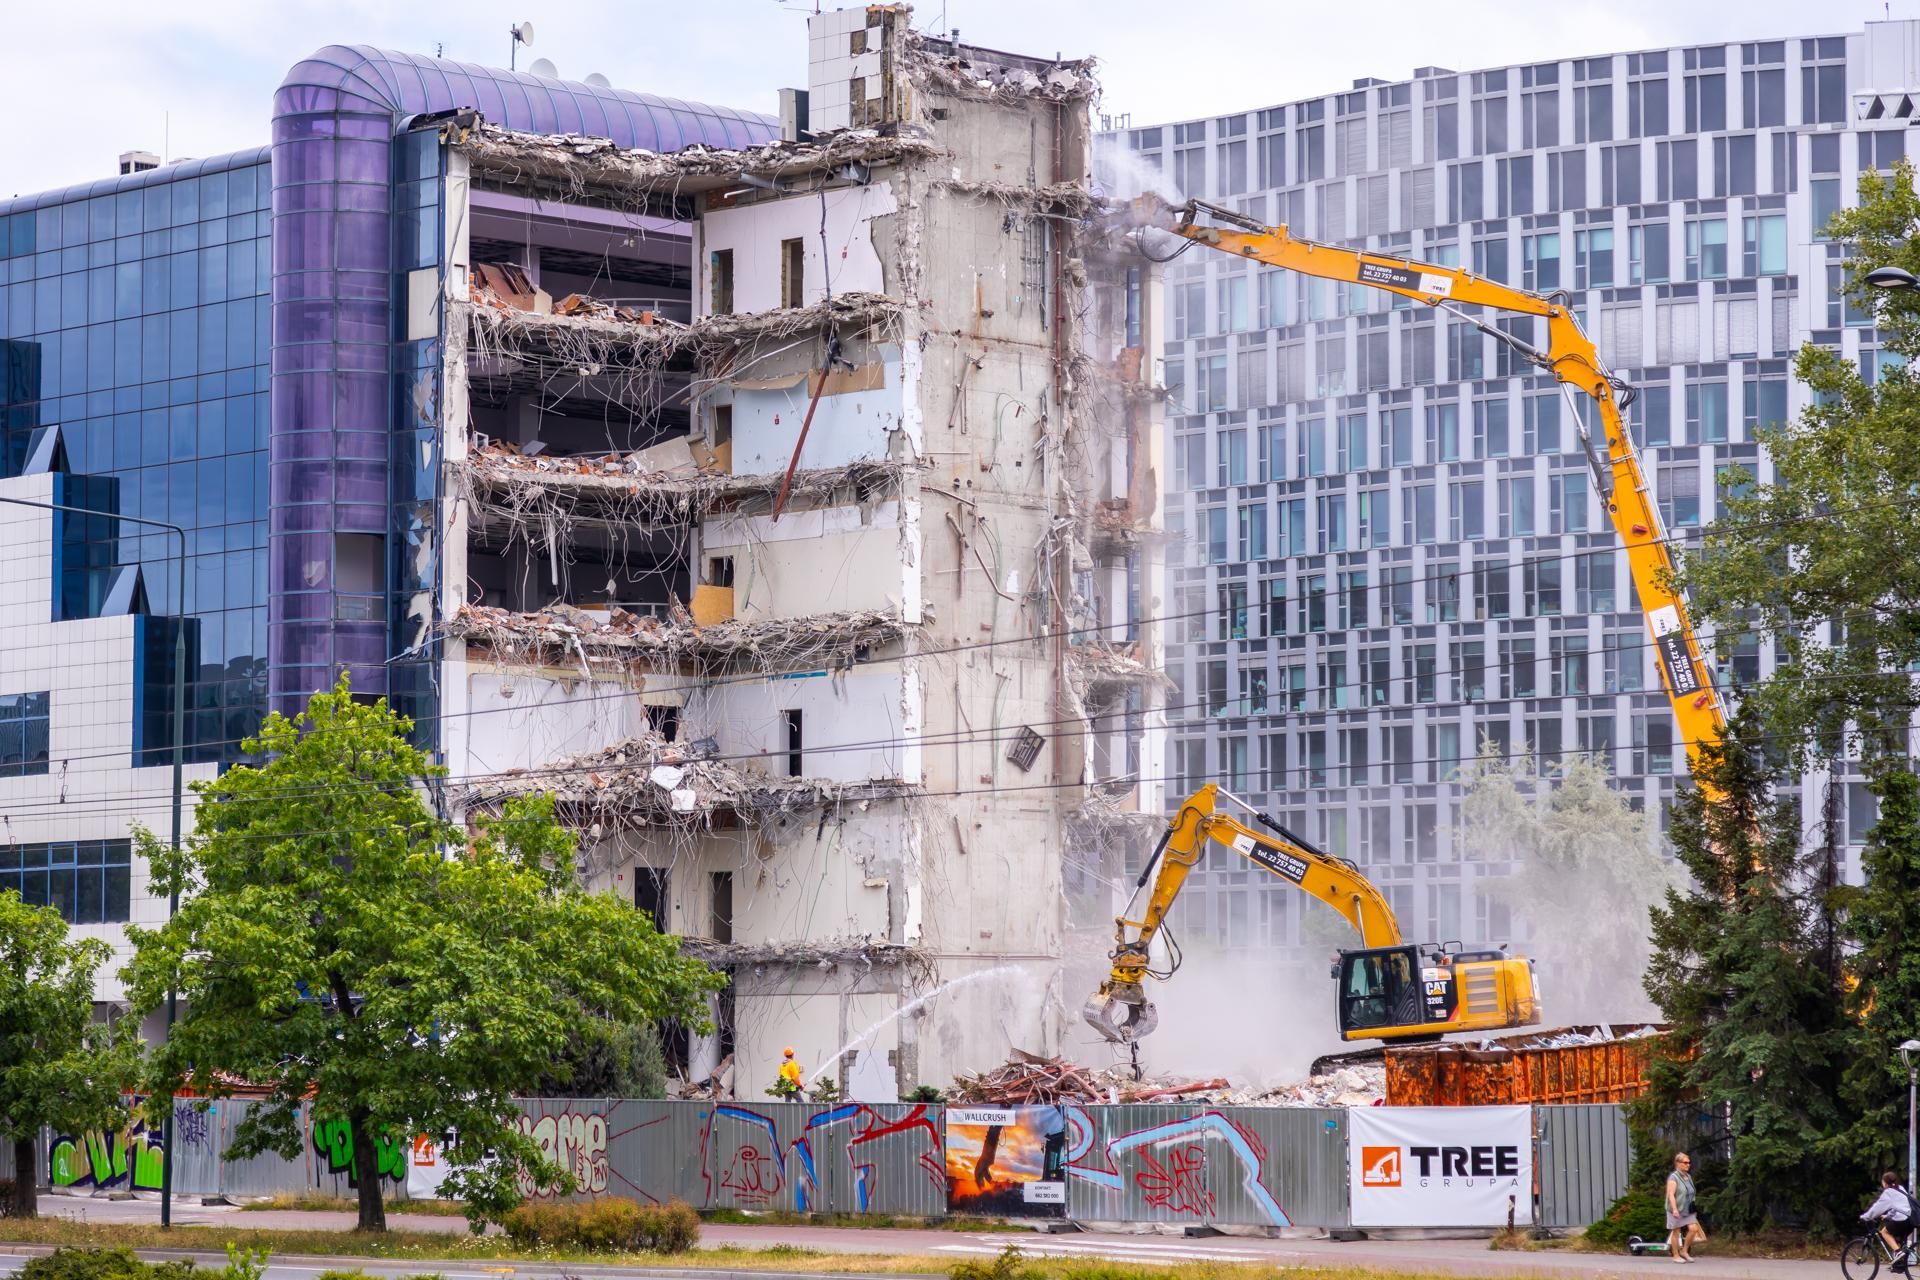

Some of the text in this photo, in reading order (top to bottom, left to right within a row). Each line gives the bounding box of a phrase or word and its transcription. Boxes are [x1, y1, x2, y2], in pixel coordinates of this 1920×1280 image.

[1671, 651, 1680, 660] 22
[1674, 660, 1684, 673] 757
[1679, 673, 1687, 682] 40
[1257, 849, 1304, 876] tel. 22 757 40 03
[1277, 851, 1307, 870] TREE GRUPA
[1425, 981, 1447, 996] CAT
[1427, 996, 1444, 1005] 320E
[964, 1112, 1007, 1122] WALLCRUSH
[1410, 1146, 1518, 1177] TREE
[1420, 1178, 1518, 1188] GRUPA
